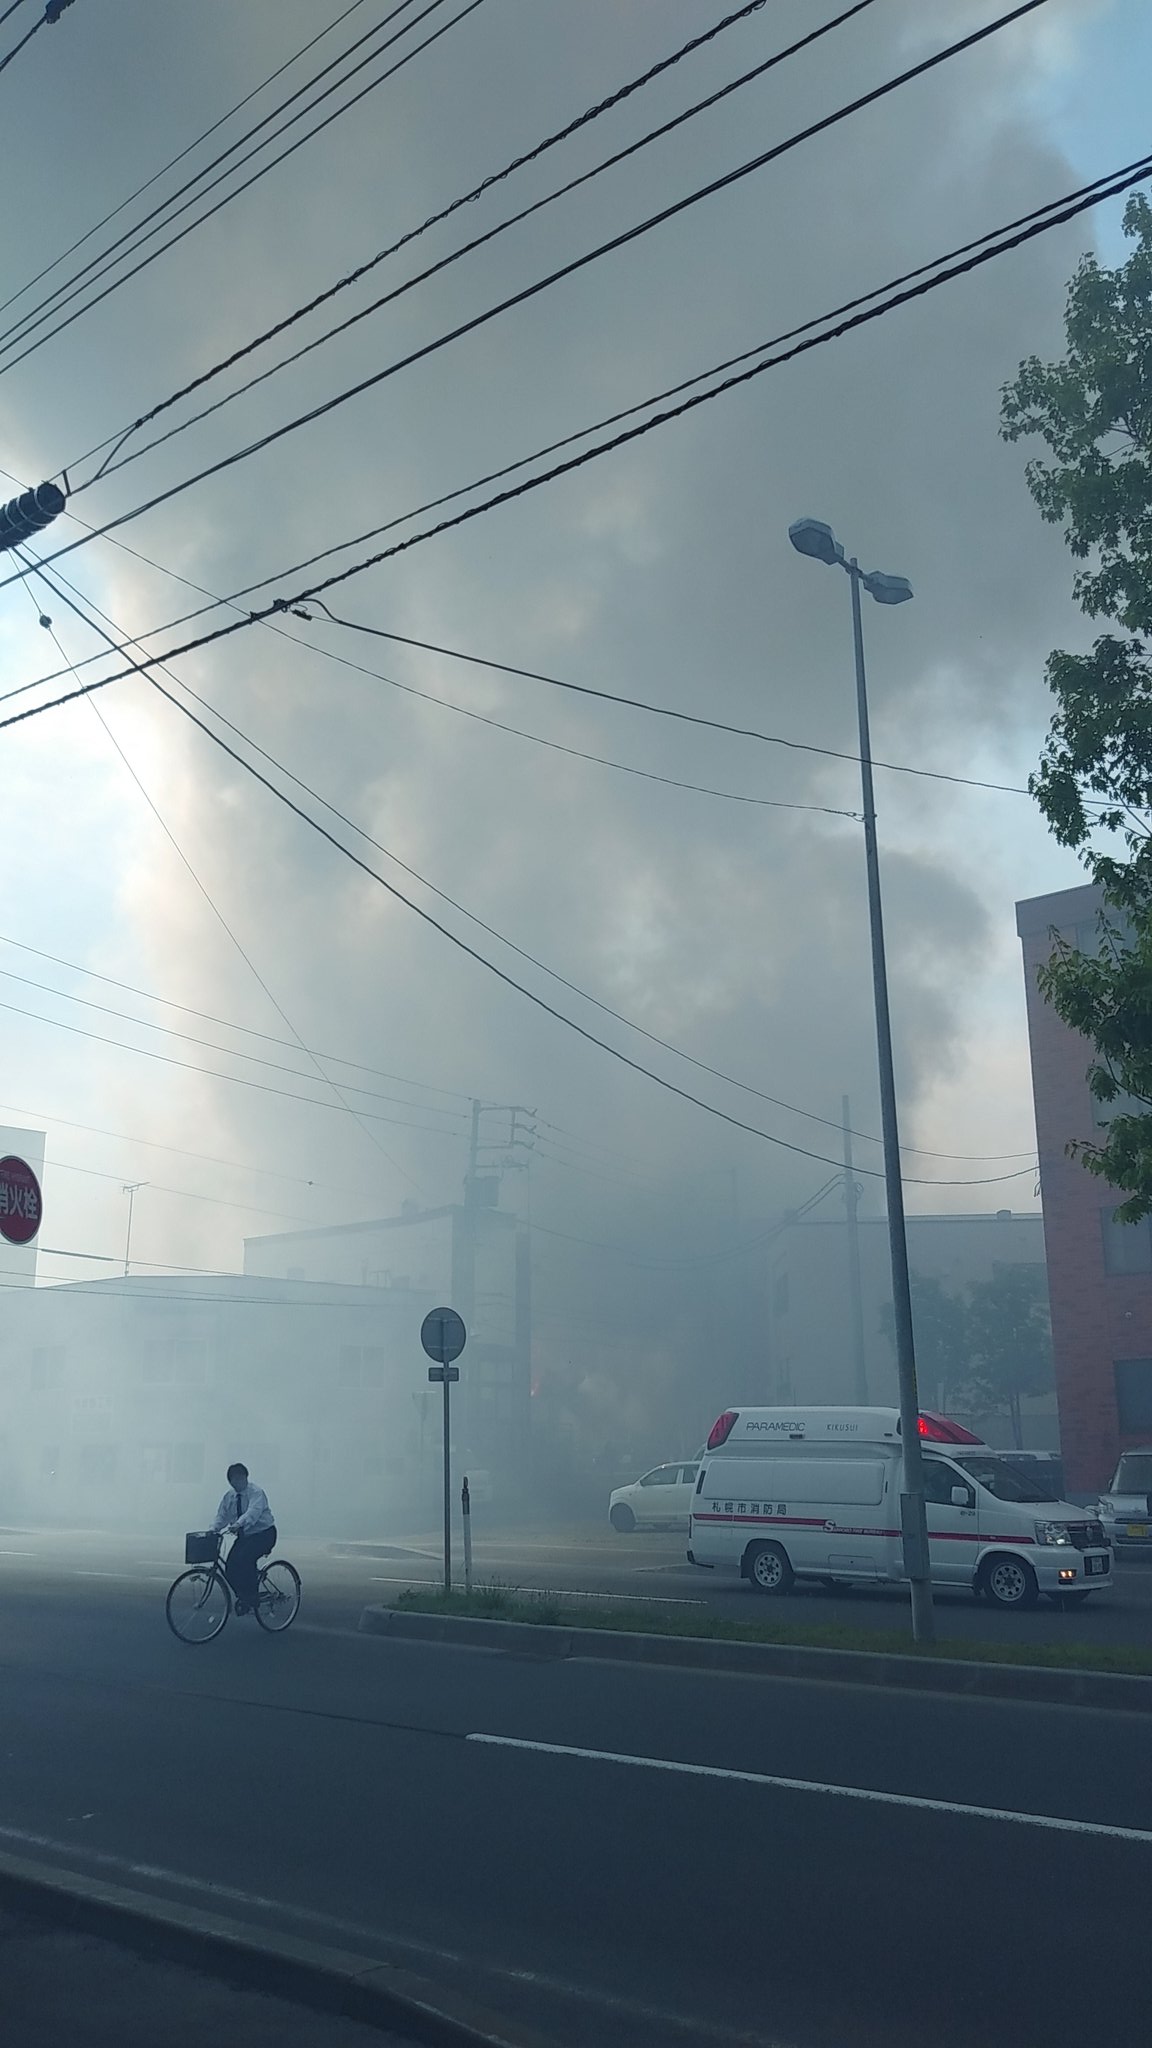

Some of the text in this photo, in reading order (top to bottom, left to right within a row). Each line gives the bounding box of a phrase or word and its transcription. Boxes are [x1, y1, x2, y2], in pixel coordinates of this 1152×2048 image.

[746, 1422, 805, 1432] PARAMEDIC
[826, 1424, 858, 1432] KIKUSUI
[712, 1502, 787, 1516] 札幌市消防局
